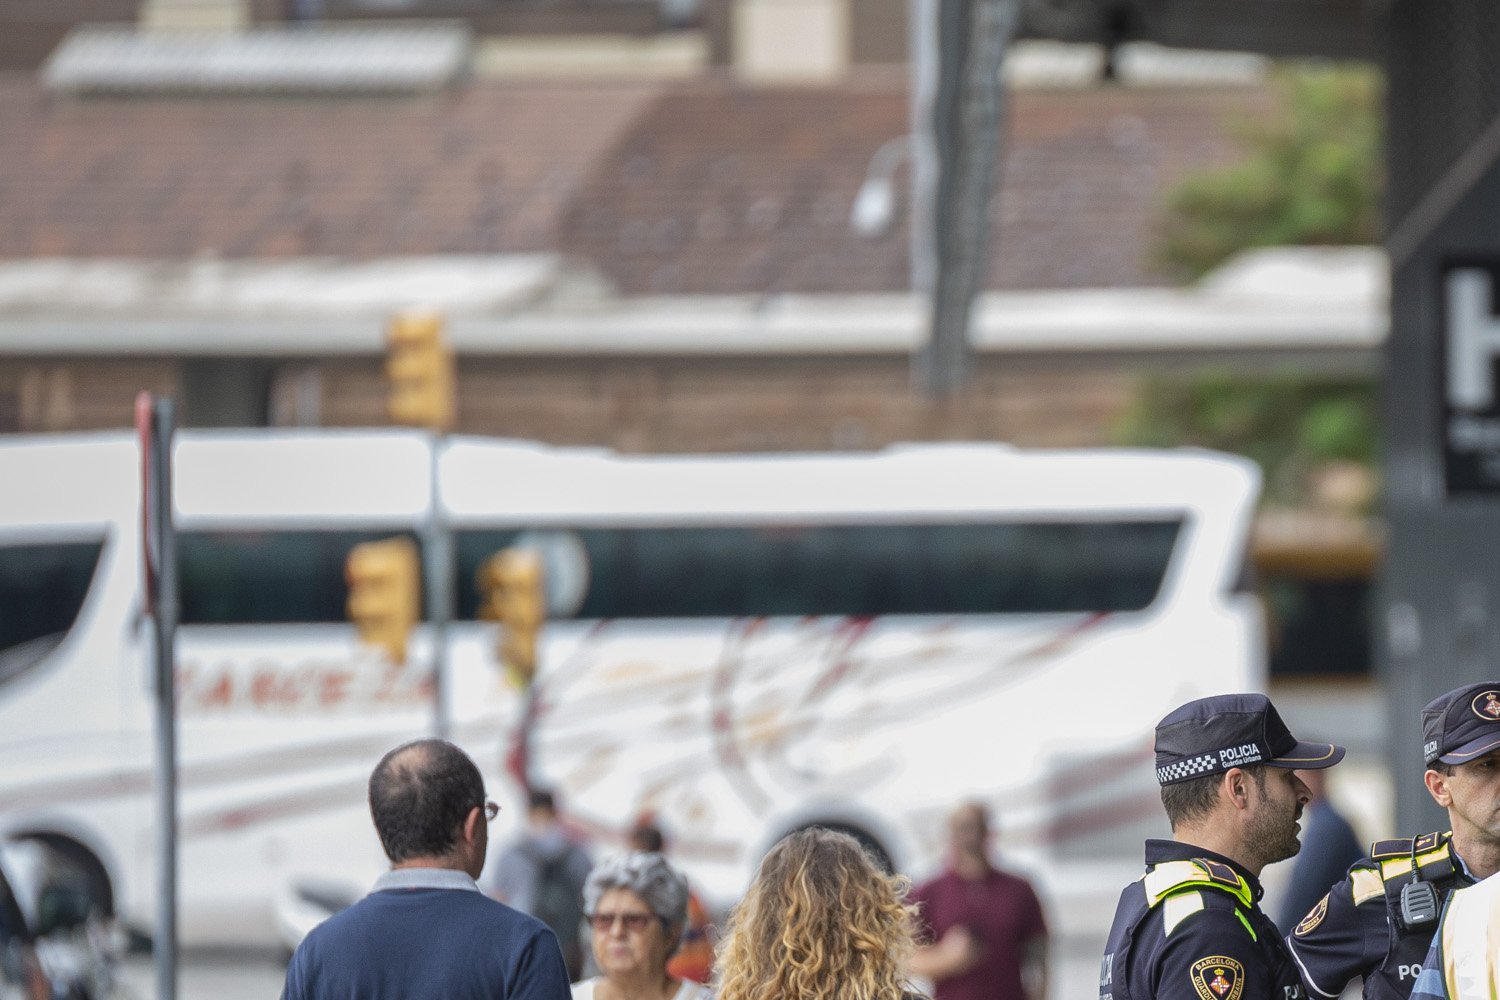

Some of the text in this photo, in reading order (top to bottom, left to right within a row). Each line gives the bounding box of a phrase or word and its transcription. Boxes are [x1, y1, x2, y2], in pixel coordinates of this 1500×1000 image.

[1219, 743, 1260, 762] POLICIA
[1195, 958, 1240, 971] BARCELONA
[1398, 963, 1423, 980] PO
